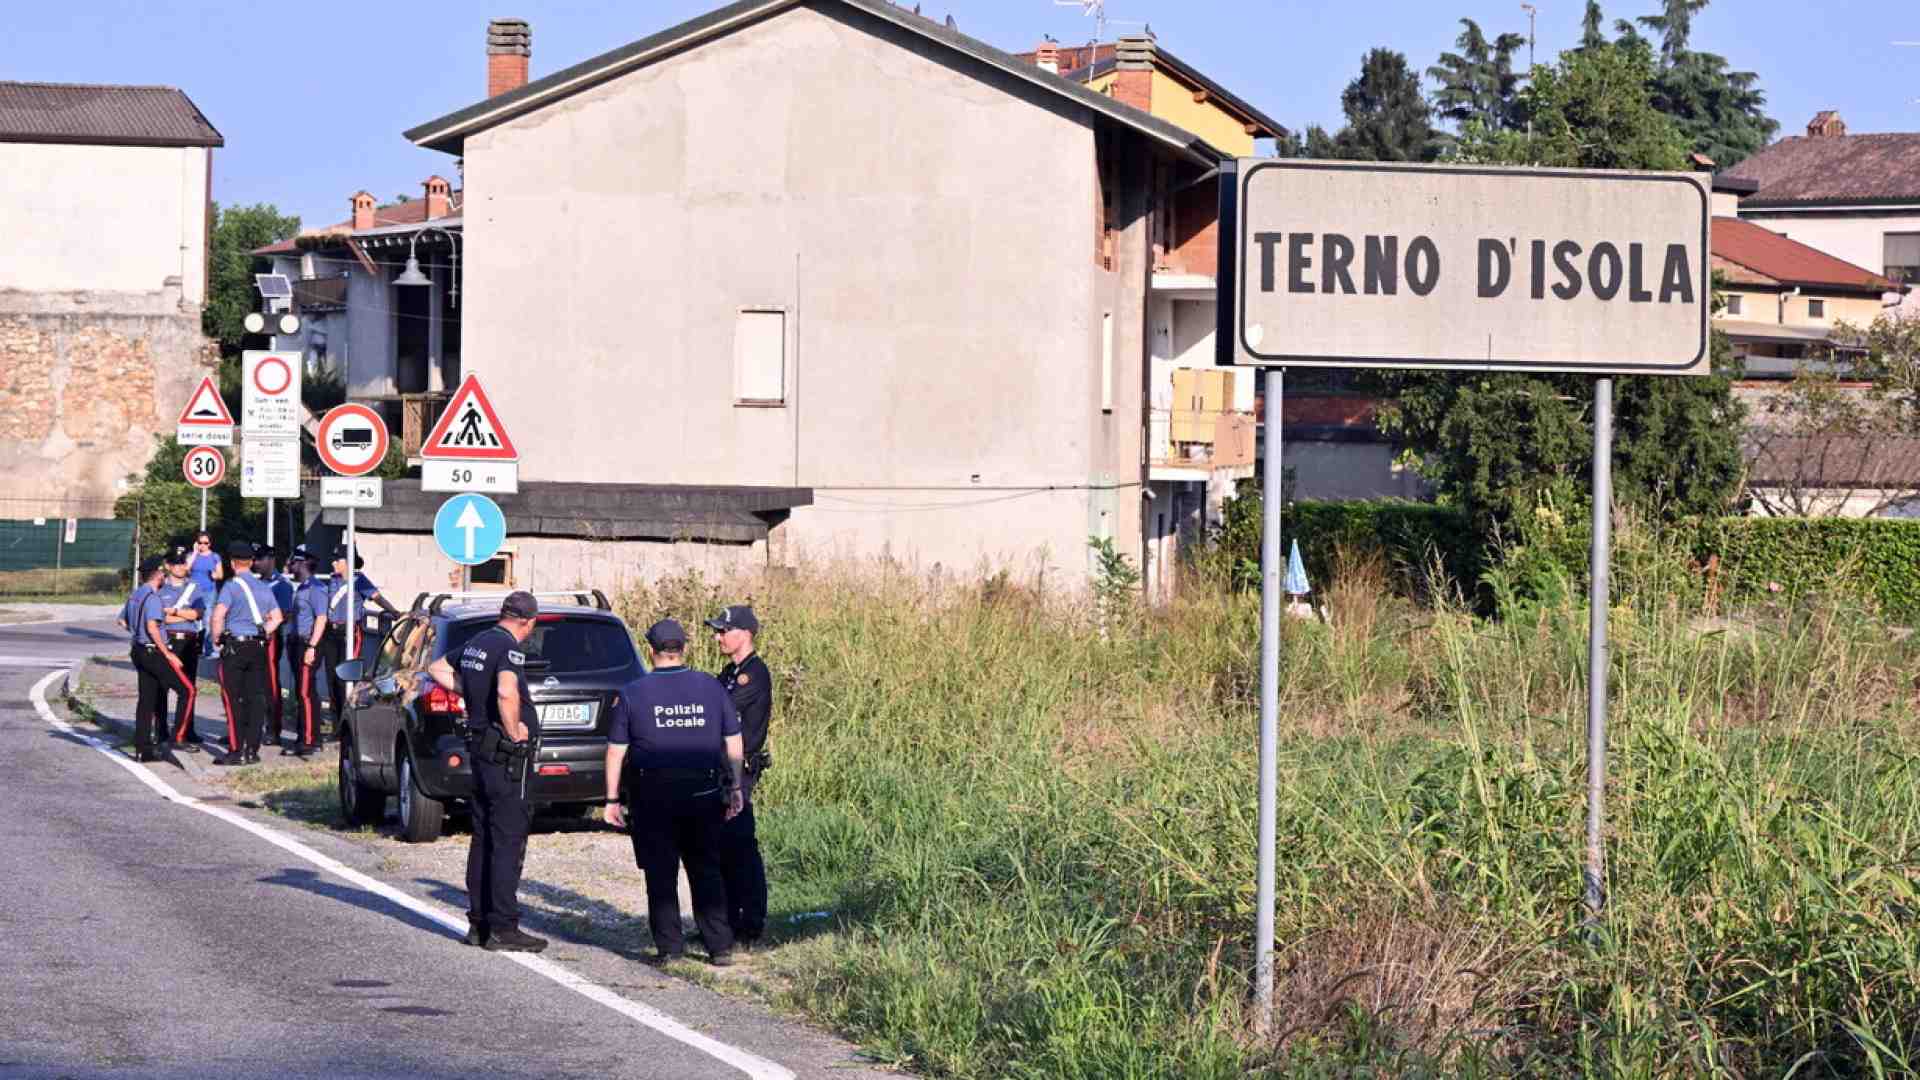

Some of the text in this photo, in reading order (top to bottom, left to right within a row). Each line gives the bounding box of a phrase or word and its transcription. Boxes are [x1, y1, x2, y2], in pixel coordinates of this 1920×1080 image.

[1254, 232, 1695, 304] TERNO D'ISOLA
[192, 456, 216, 477] 30
[451, 469, 496, 484] 50 m
[653, 703, 705, 717] Polizia
[655, 717, 706, 728] Locale
